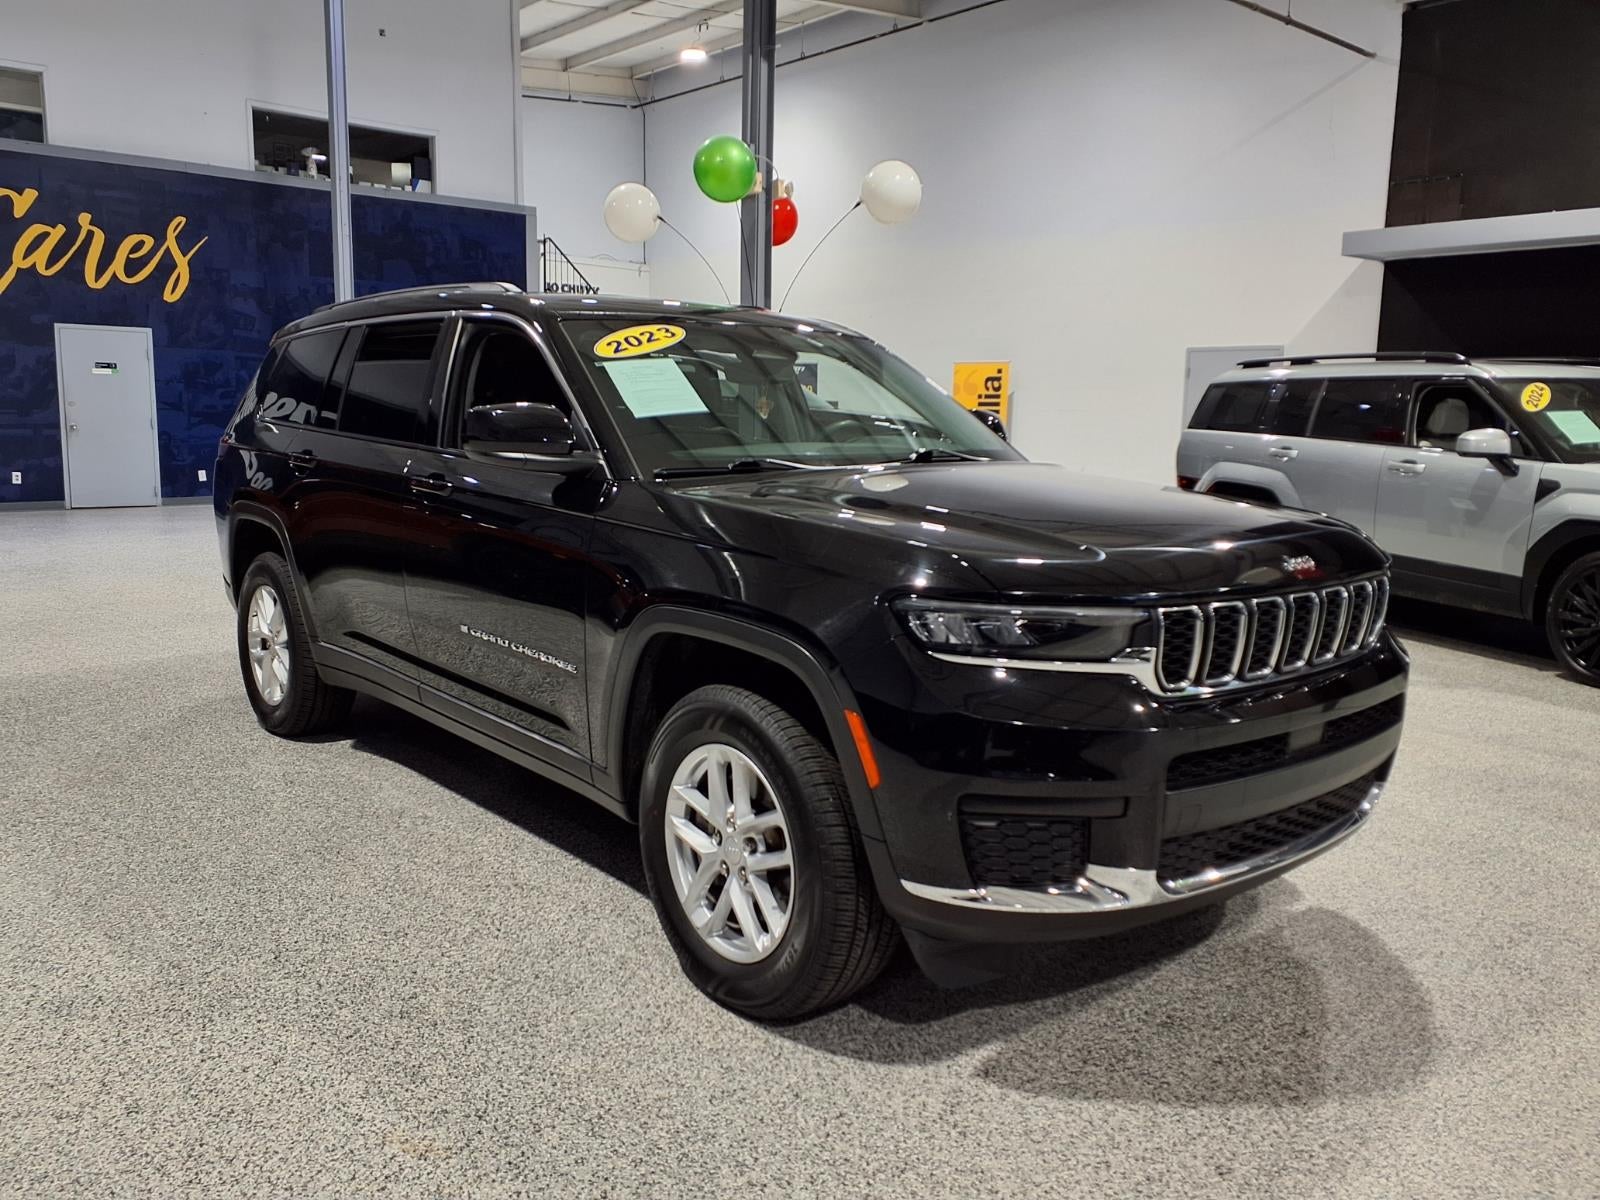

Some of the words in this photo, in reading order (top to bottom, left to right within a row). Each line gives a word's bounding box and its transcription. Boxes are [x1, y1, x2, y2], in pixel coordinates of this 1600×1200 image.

[606, 327, 676, 354] 2023
[470, 628, 509, 647] GRAND
[510, 642, 577, 673] CHEROKEE
